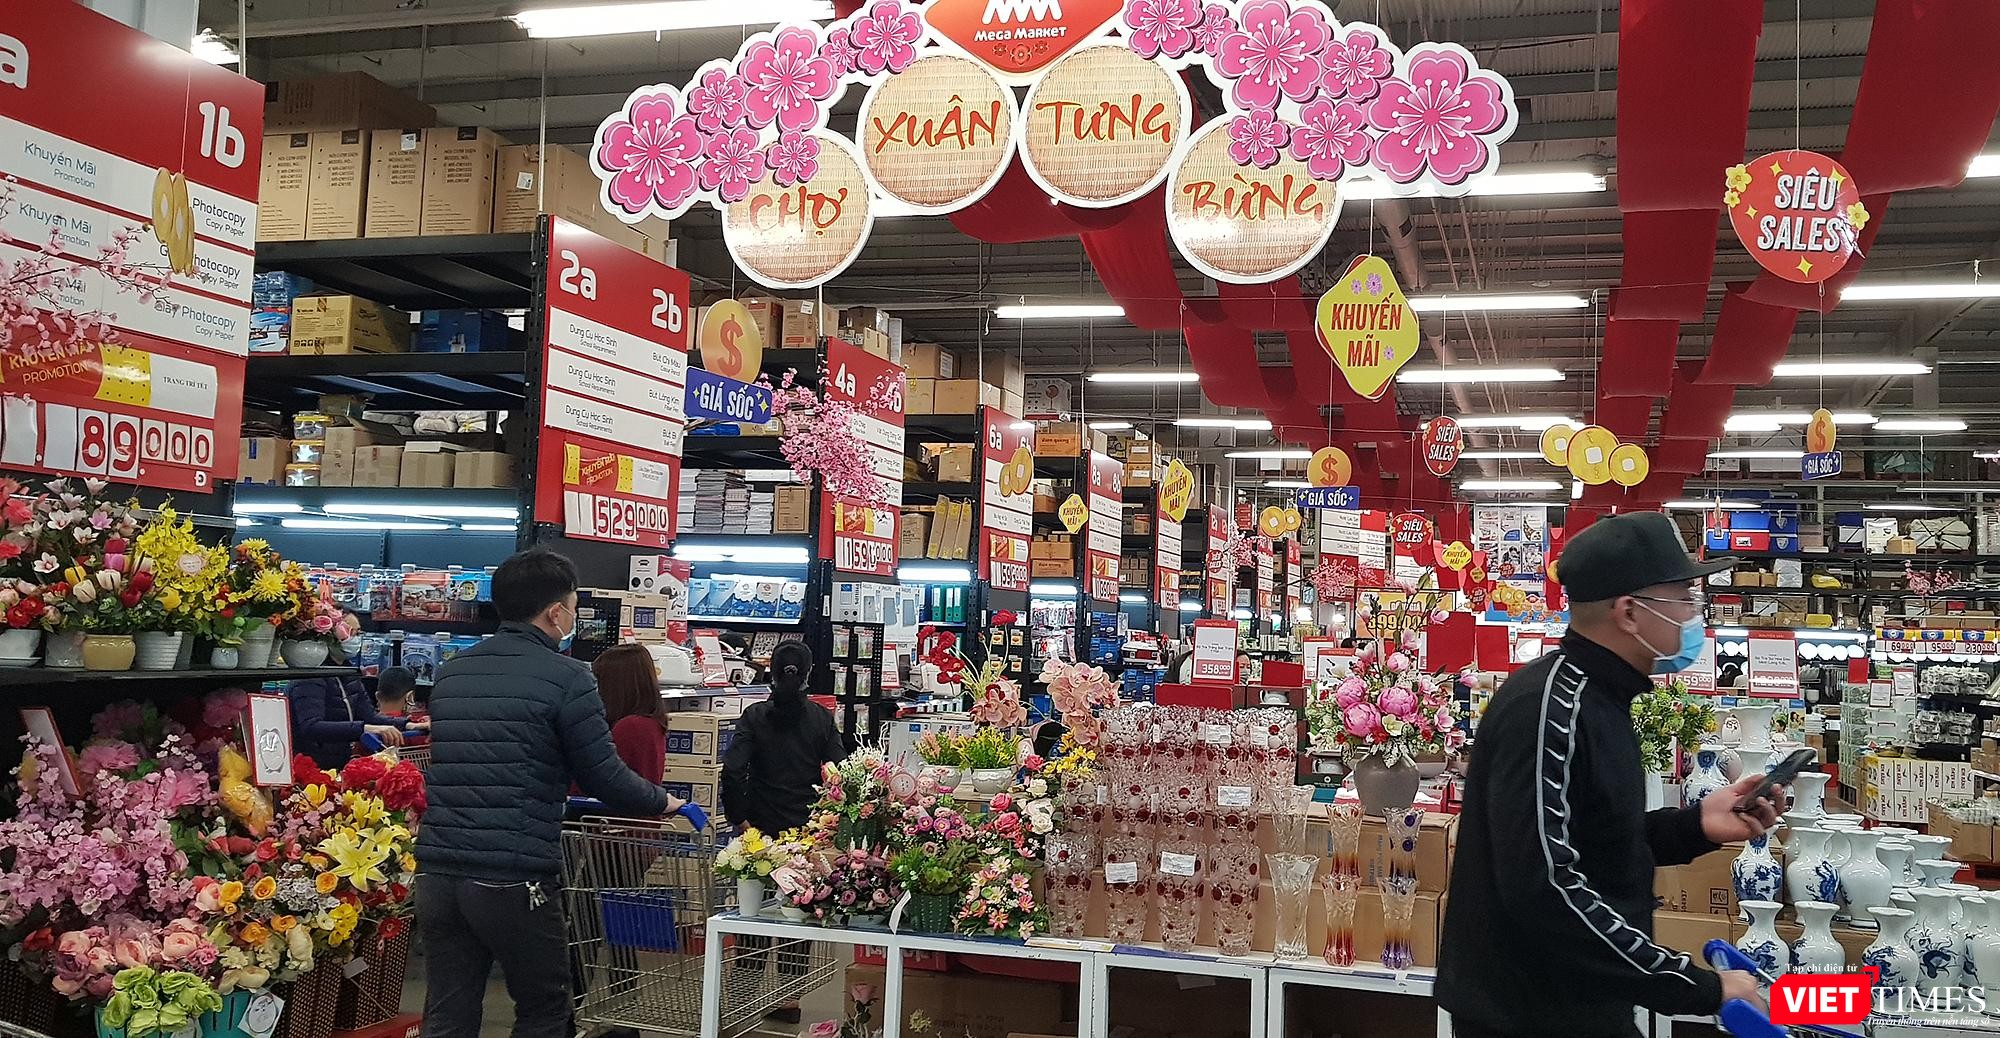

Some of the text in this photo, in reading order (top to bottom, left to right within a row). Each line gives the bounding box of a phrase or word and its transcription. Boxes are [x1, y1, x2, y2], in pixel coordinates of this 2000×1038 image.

[874, 94, 1001, 152] XUÂN
[1035, 94, 1171, 145] TƯNG
[199, 102, 245, 168] 1b
[24, 140, 72, 168] Khuyến
[54, 169, 95, 189] Promotion
[1775, 167, 1838, 211] SIÊU
[192, 197, 246, 225] Photocopy
[749, 187, 848, 236] CHỢ
[1183, 174, 1324, 223] BỪNG
[206, 218, 245, 237] Copy Paper
[1757, 215, 1842, 251] SALES
[194, 253, 240, 279] hotocopy
[559, 250, 597, 301] 2a
[218, 277, 239, 289] Paper
[181, 305, 236, 331] Photocopy
[651, 289, 682, 333] 2b
[1331, 292, 1402, 331] KHUYẾN
[195, 325, 235, 341] Copy Paper
[1347, 334, 1380, 367] MÃI
[23, 360, 88, 384] PROMOTION
[835, 363, 855, 397] 4a
[699, 381, 754, 420] GIÁ SỐC
[988, 424, 1002, 450] 6a
[1435, 422, 1457, 443] SIÊU
[1429, 444, 1455, 461] SALES
[1807, 453, 1832, 473] GIÁ SỐC
[1164, 472, 1187, 499] KHUYẾN
[1308, 488, 1347, 506] GIÁ SỐC
[1062, 504, 1084, 516] KHUYẾN
[1170, 495, 1180, 512] MÃI
[1067, 515, 1077, 526] MÃI
[1402, 519, 1423, 531] SIÊU
[1396, 531, 1424, 543] SALES
[1446, 549, 1467, 558] KHUYẾN
[1450, 556, 1460, 564] MÃI
